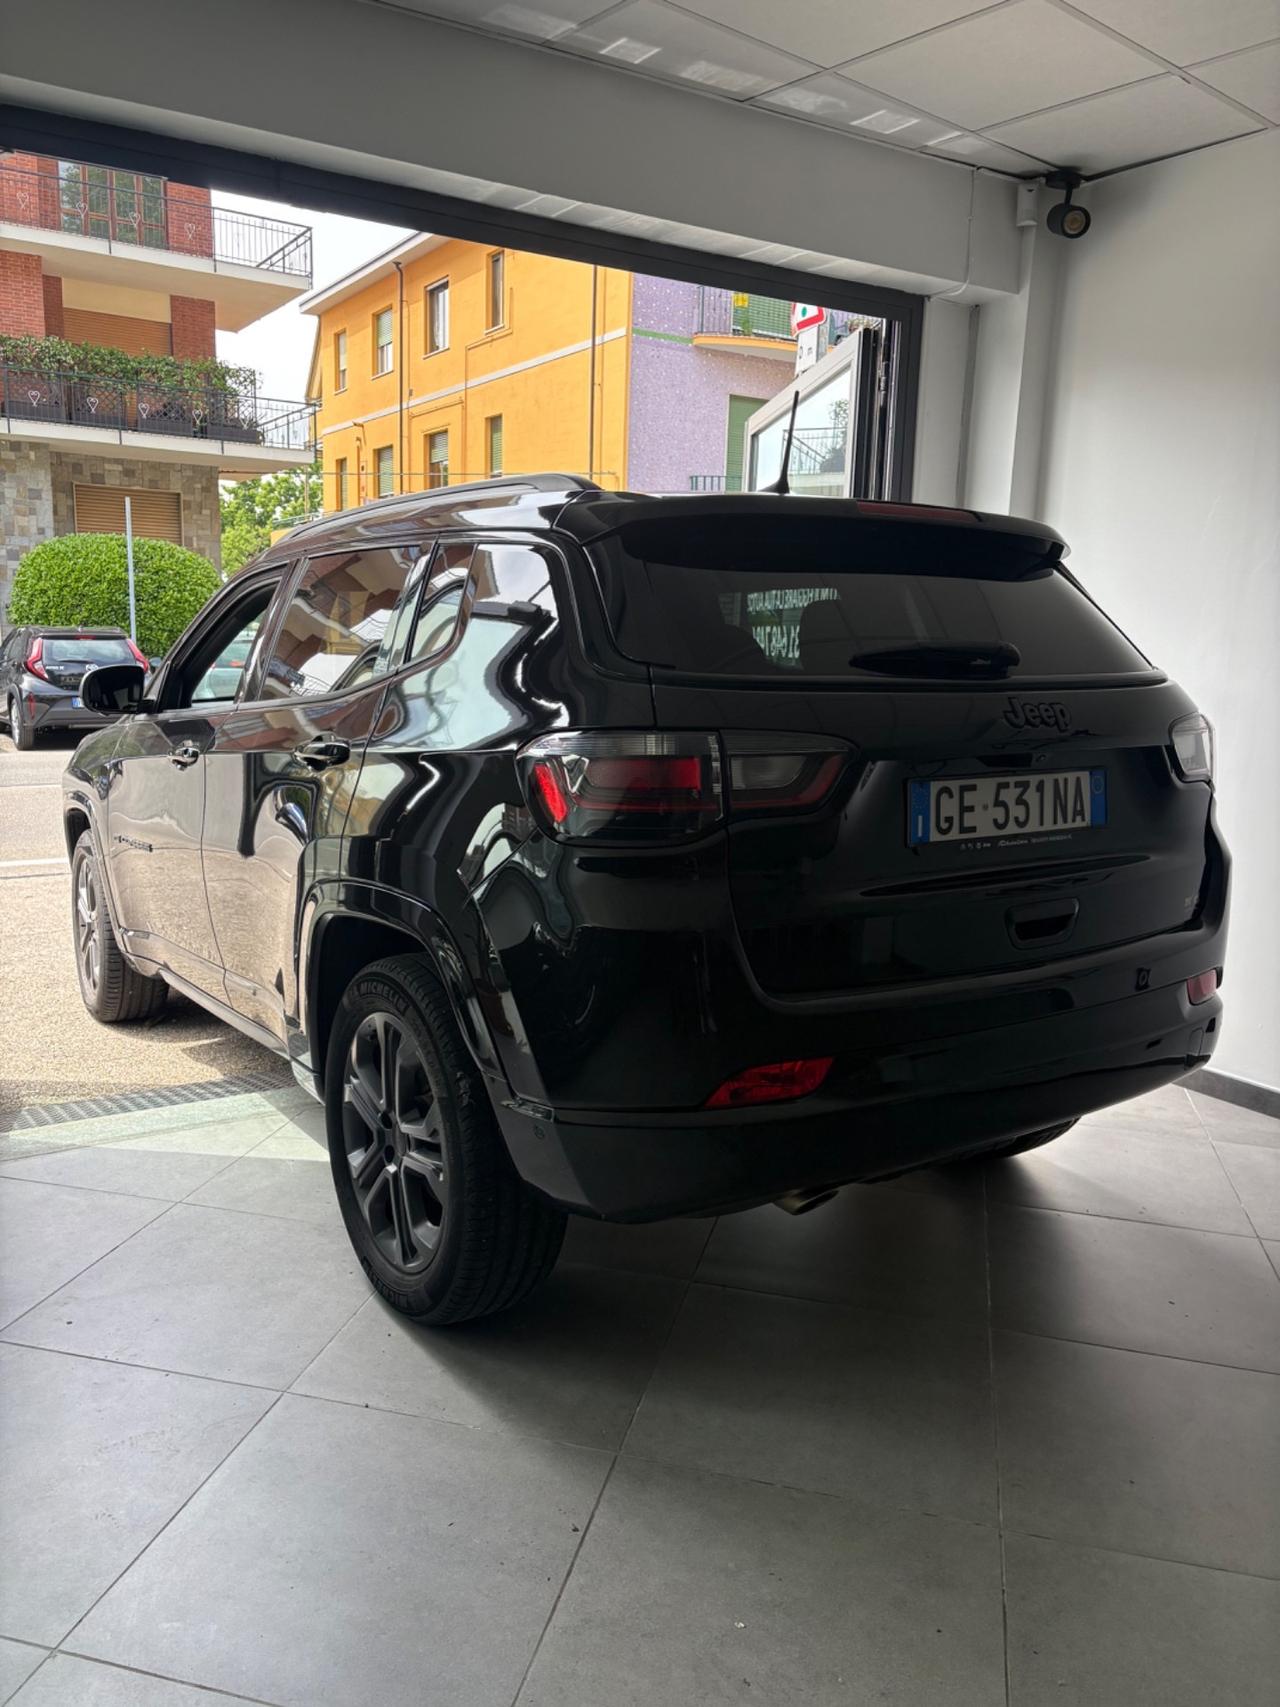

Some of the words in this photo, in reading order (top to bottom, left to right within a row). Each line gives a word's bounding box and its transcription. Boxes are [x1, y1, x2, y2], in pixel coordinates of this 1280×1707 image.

[1003, 697, 1071, 733] Jeep
[935, 784, 977, 836] GE
[992, 776, 1086, 831] 531NA
[359, 980, 409, 1015] MICHELIN
